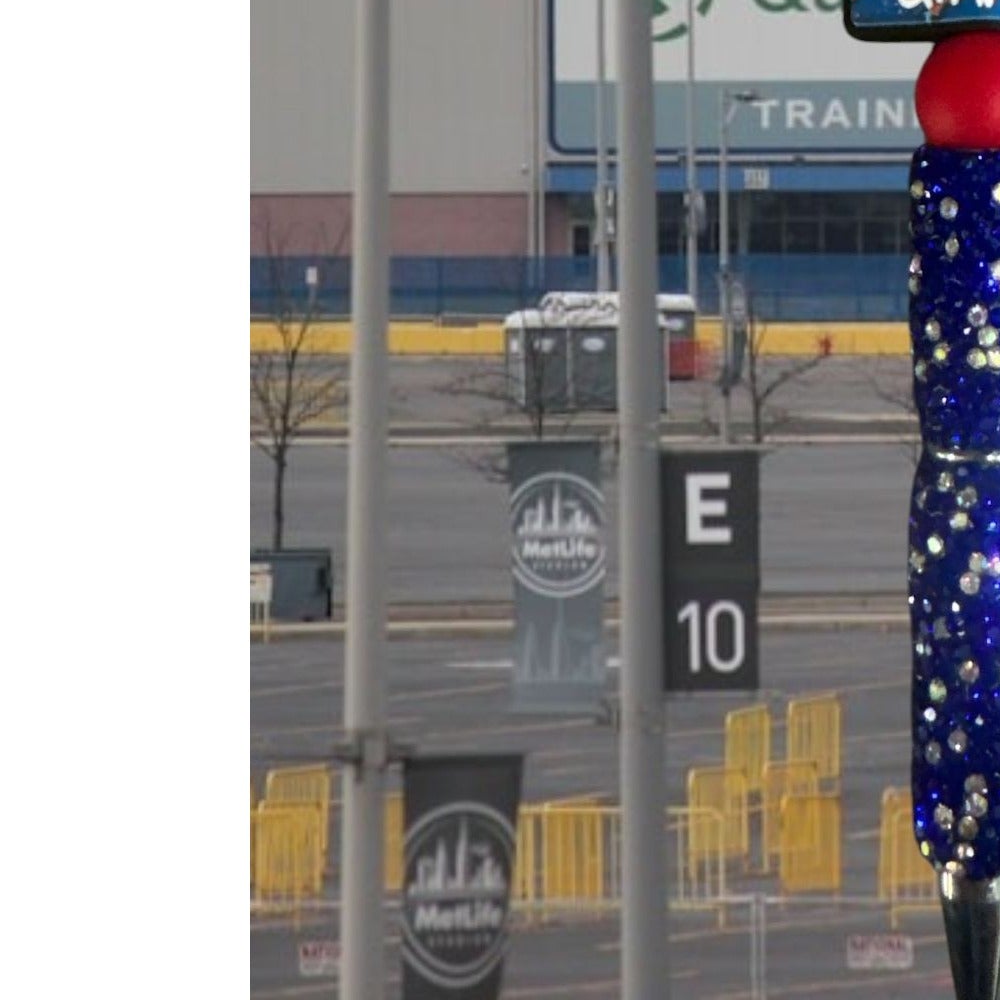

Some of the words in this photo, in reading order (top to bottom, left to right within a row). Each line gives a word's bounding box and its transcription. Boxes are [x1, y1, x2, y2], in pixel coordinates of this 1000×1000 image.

[685, 473, 731, 544] E
[522, 538, 596, 559] MetLife
[677, 601, 745, 673] 10
